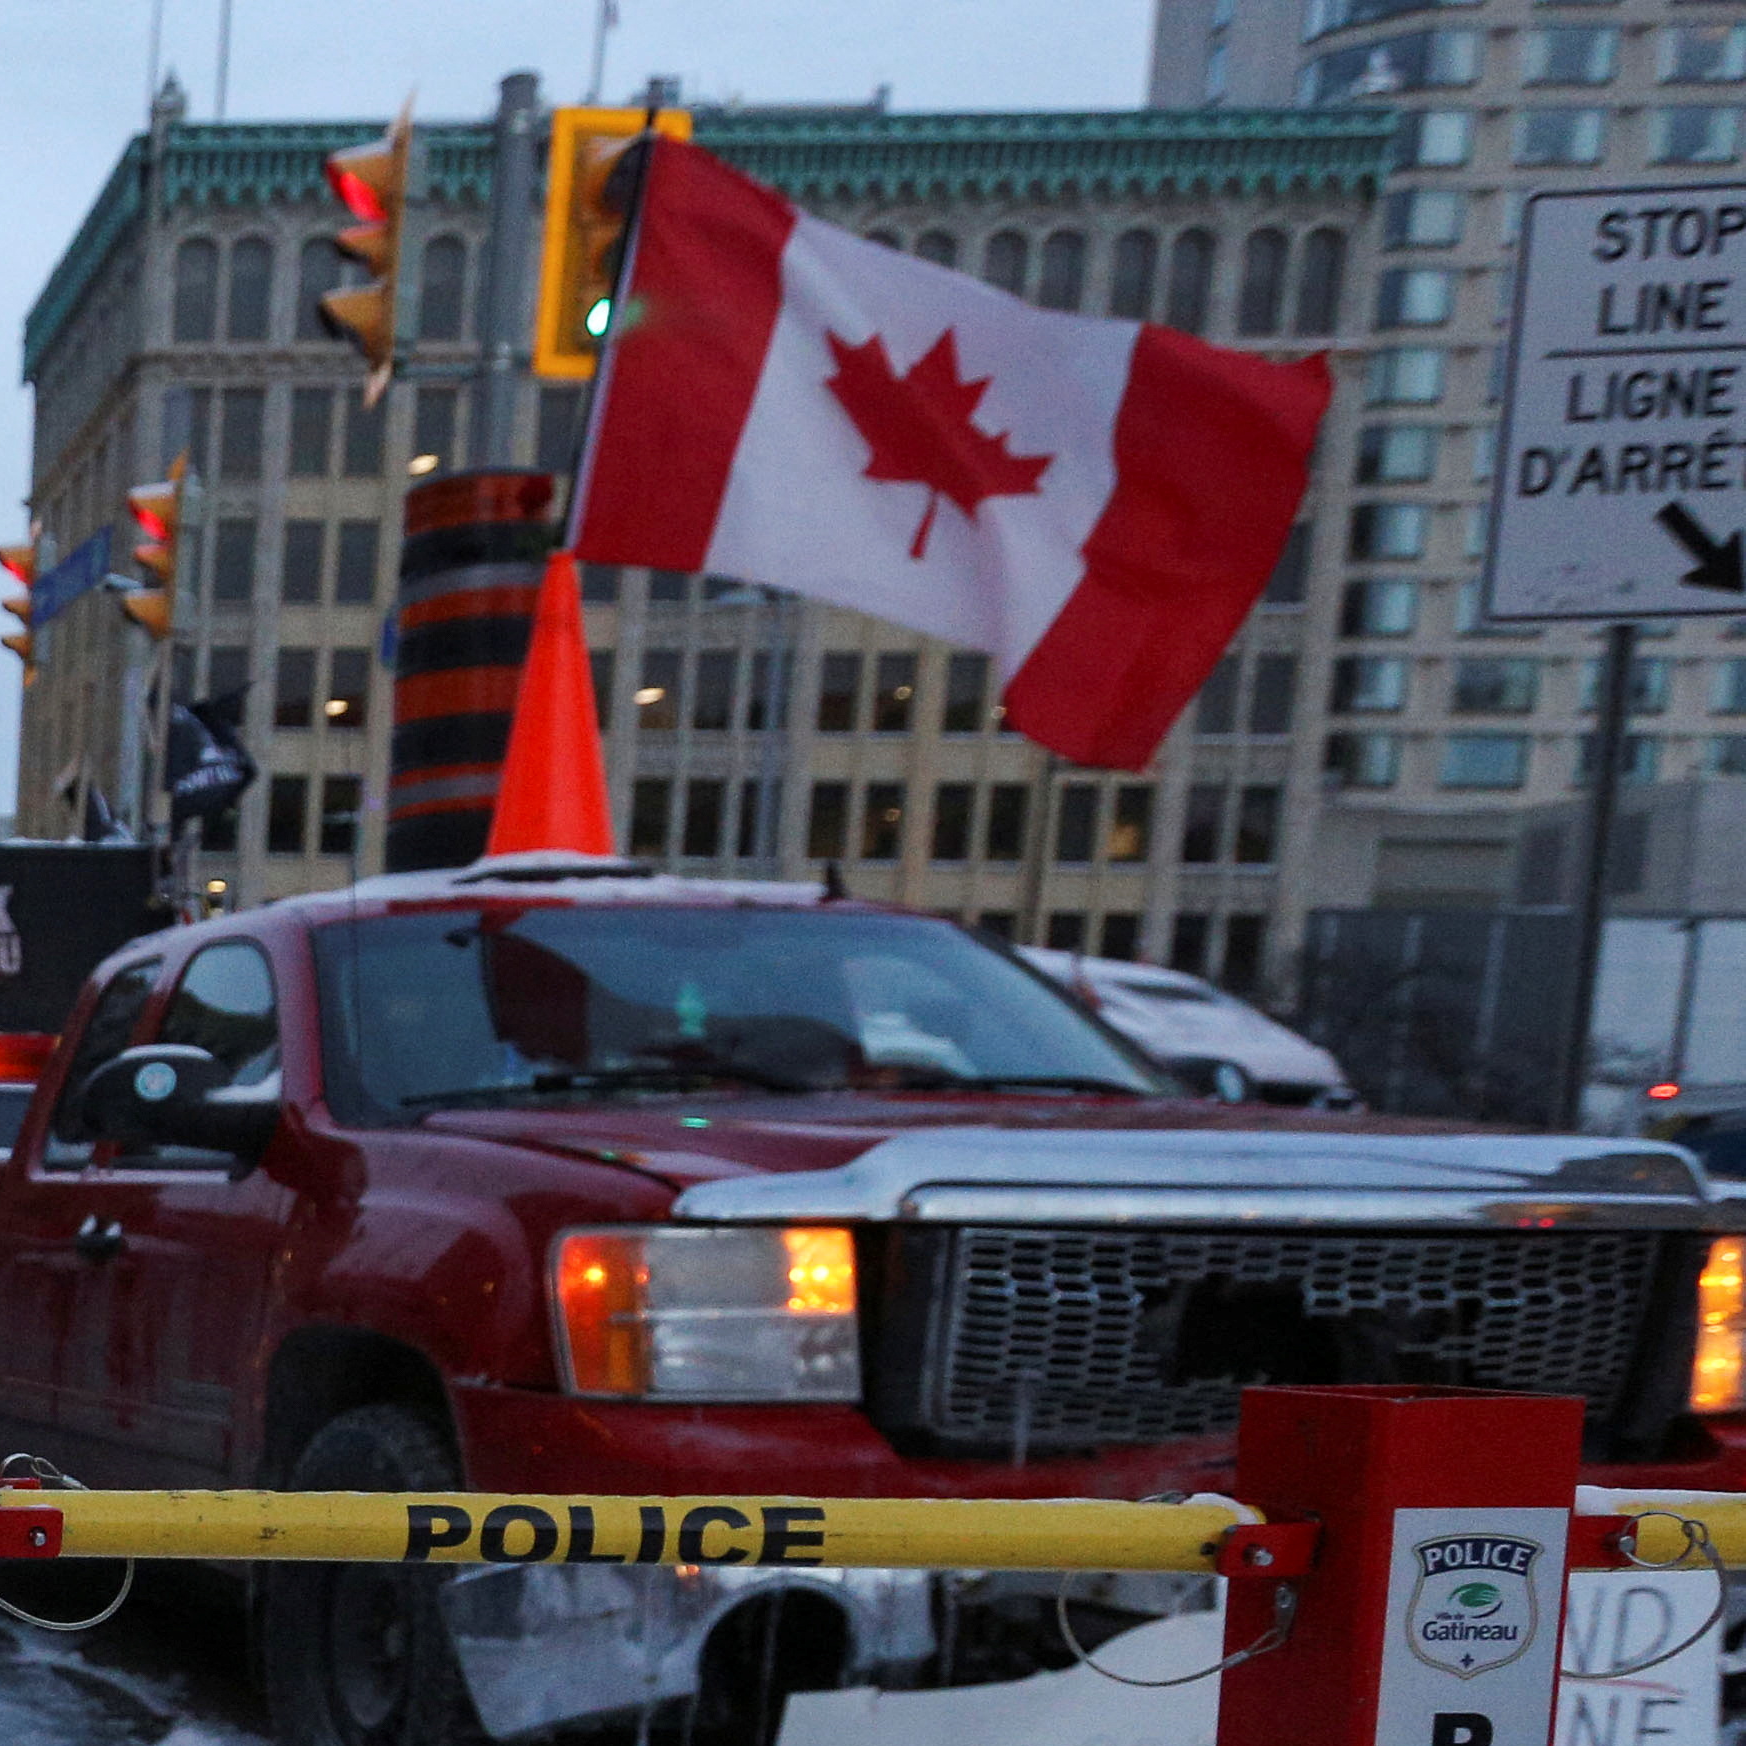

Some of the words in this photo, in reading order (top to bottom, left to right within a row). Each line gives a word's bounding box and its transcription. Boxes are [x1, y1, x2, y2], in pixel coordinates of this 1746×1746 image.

[1594, 205, 1746, 262] STOP
[1597, 277, 1735, 337] LINE
[1566, 364, 1742, 424] LIGNE
[402, 1503, 827, 1567] POLICE
[1423, 1542, 1532, 1572] POLICE
[1421, 1620, 1518, 1641] Gatineau
